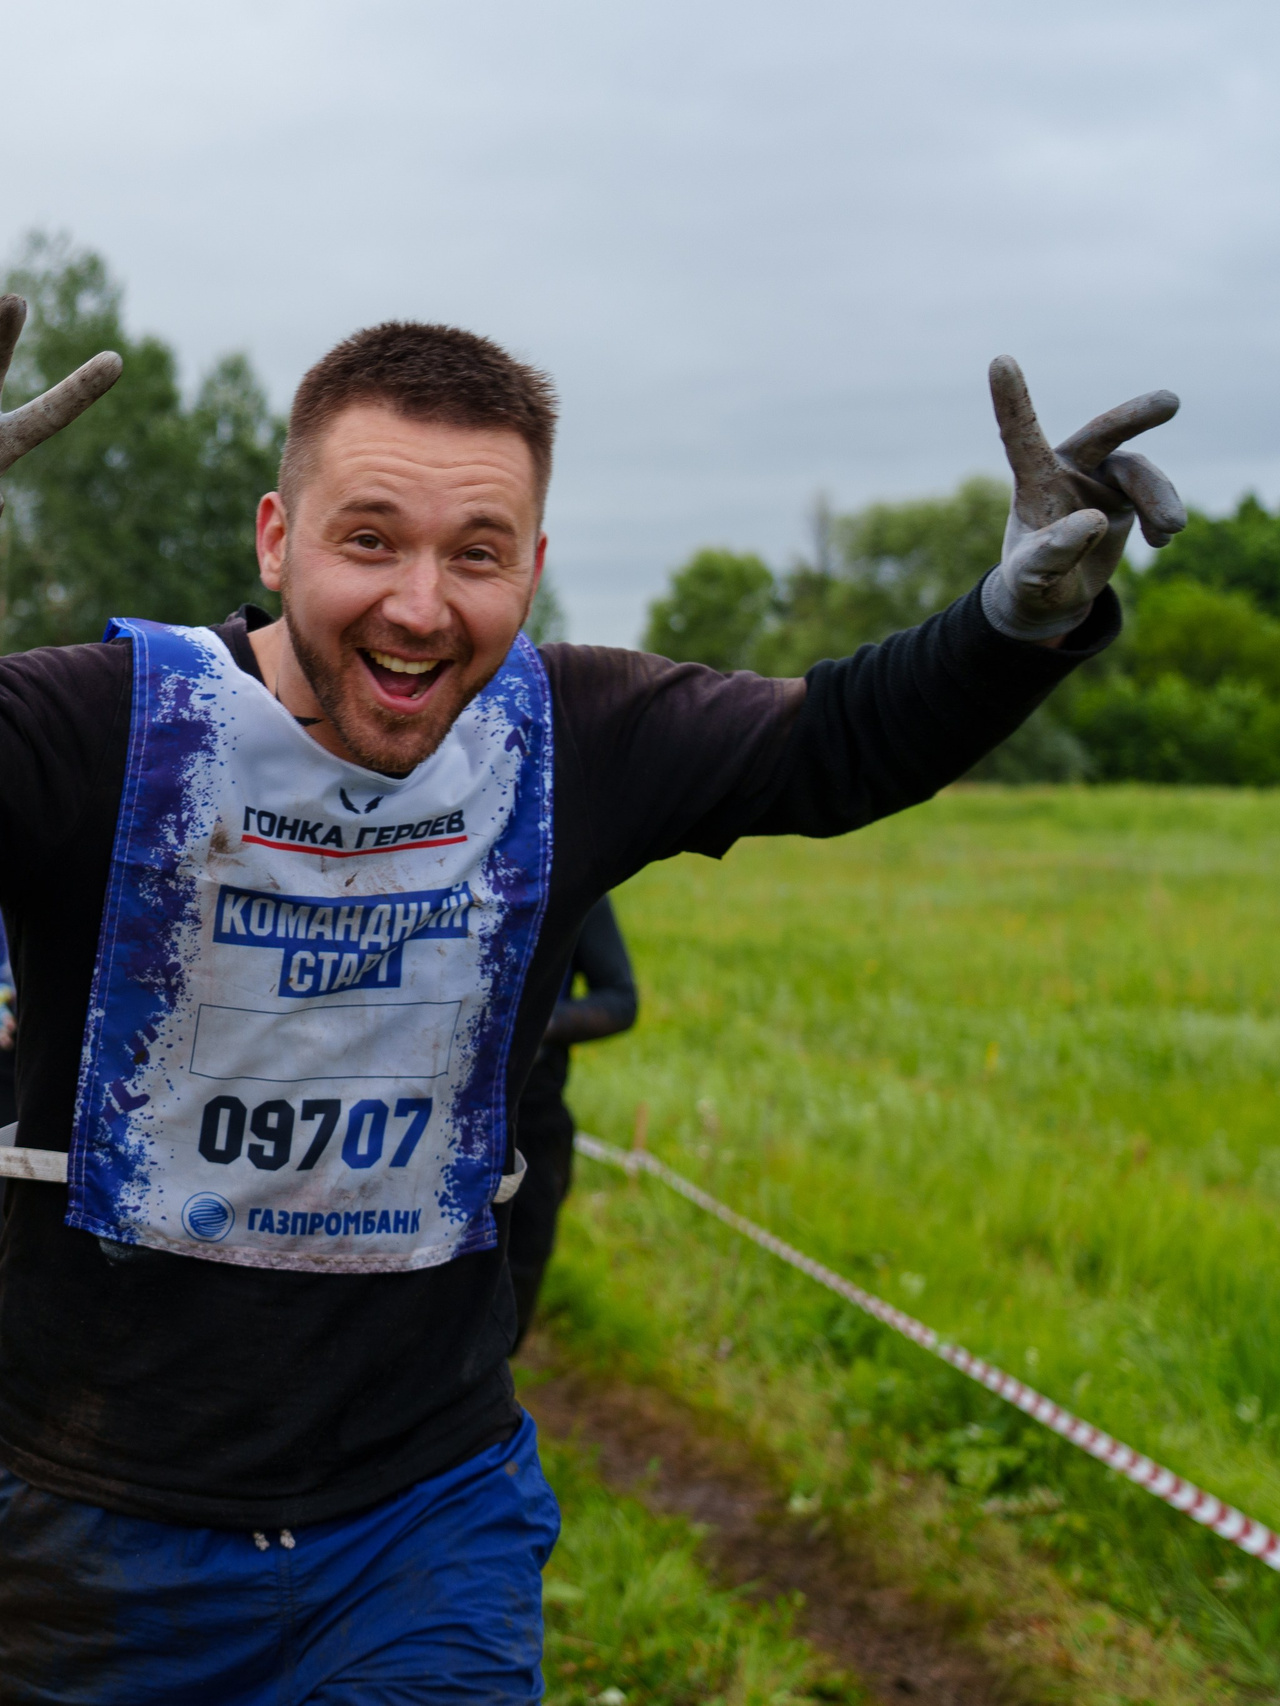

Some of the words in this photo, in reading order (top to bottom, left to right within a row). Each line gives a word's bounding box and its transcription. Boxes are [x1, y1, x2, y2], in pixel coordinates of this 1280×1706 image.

[243, 806, 344, 848] ГОНКА
[355, 810, 466, 849] ГЕРОЕВ
[221, 884, 471, 950] КОМАНДНЫЙ
[288, 950, 397, 992] СТАРТ
[198, 1095, 433, 1172] 09707
[247, 1207, 422, 1236] ГАЗПРОМБАНК
